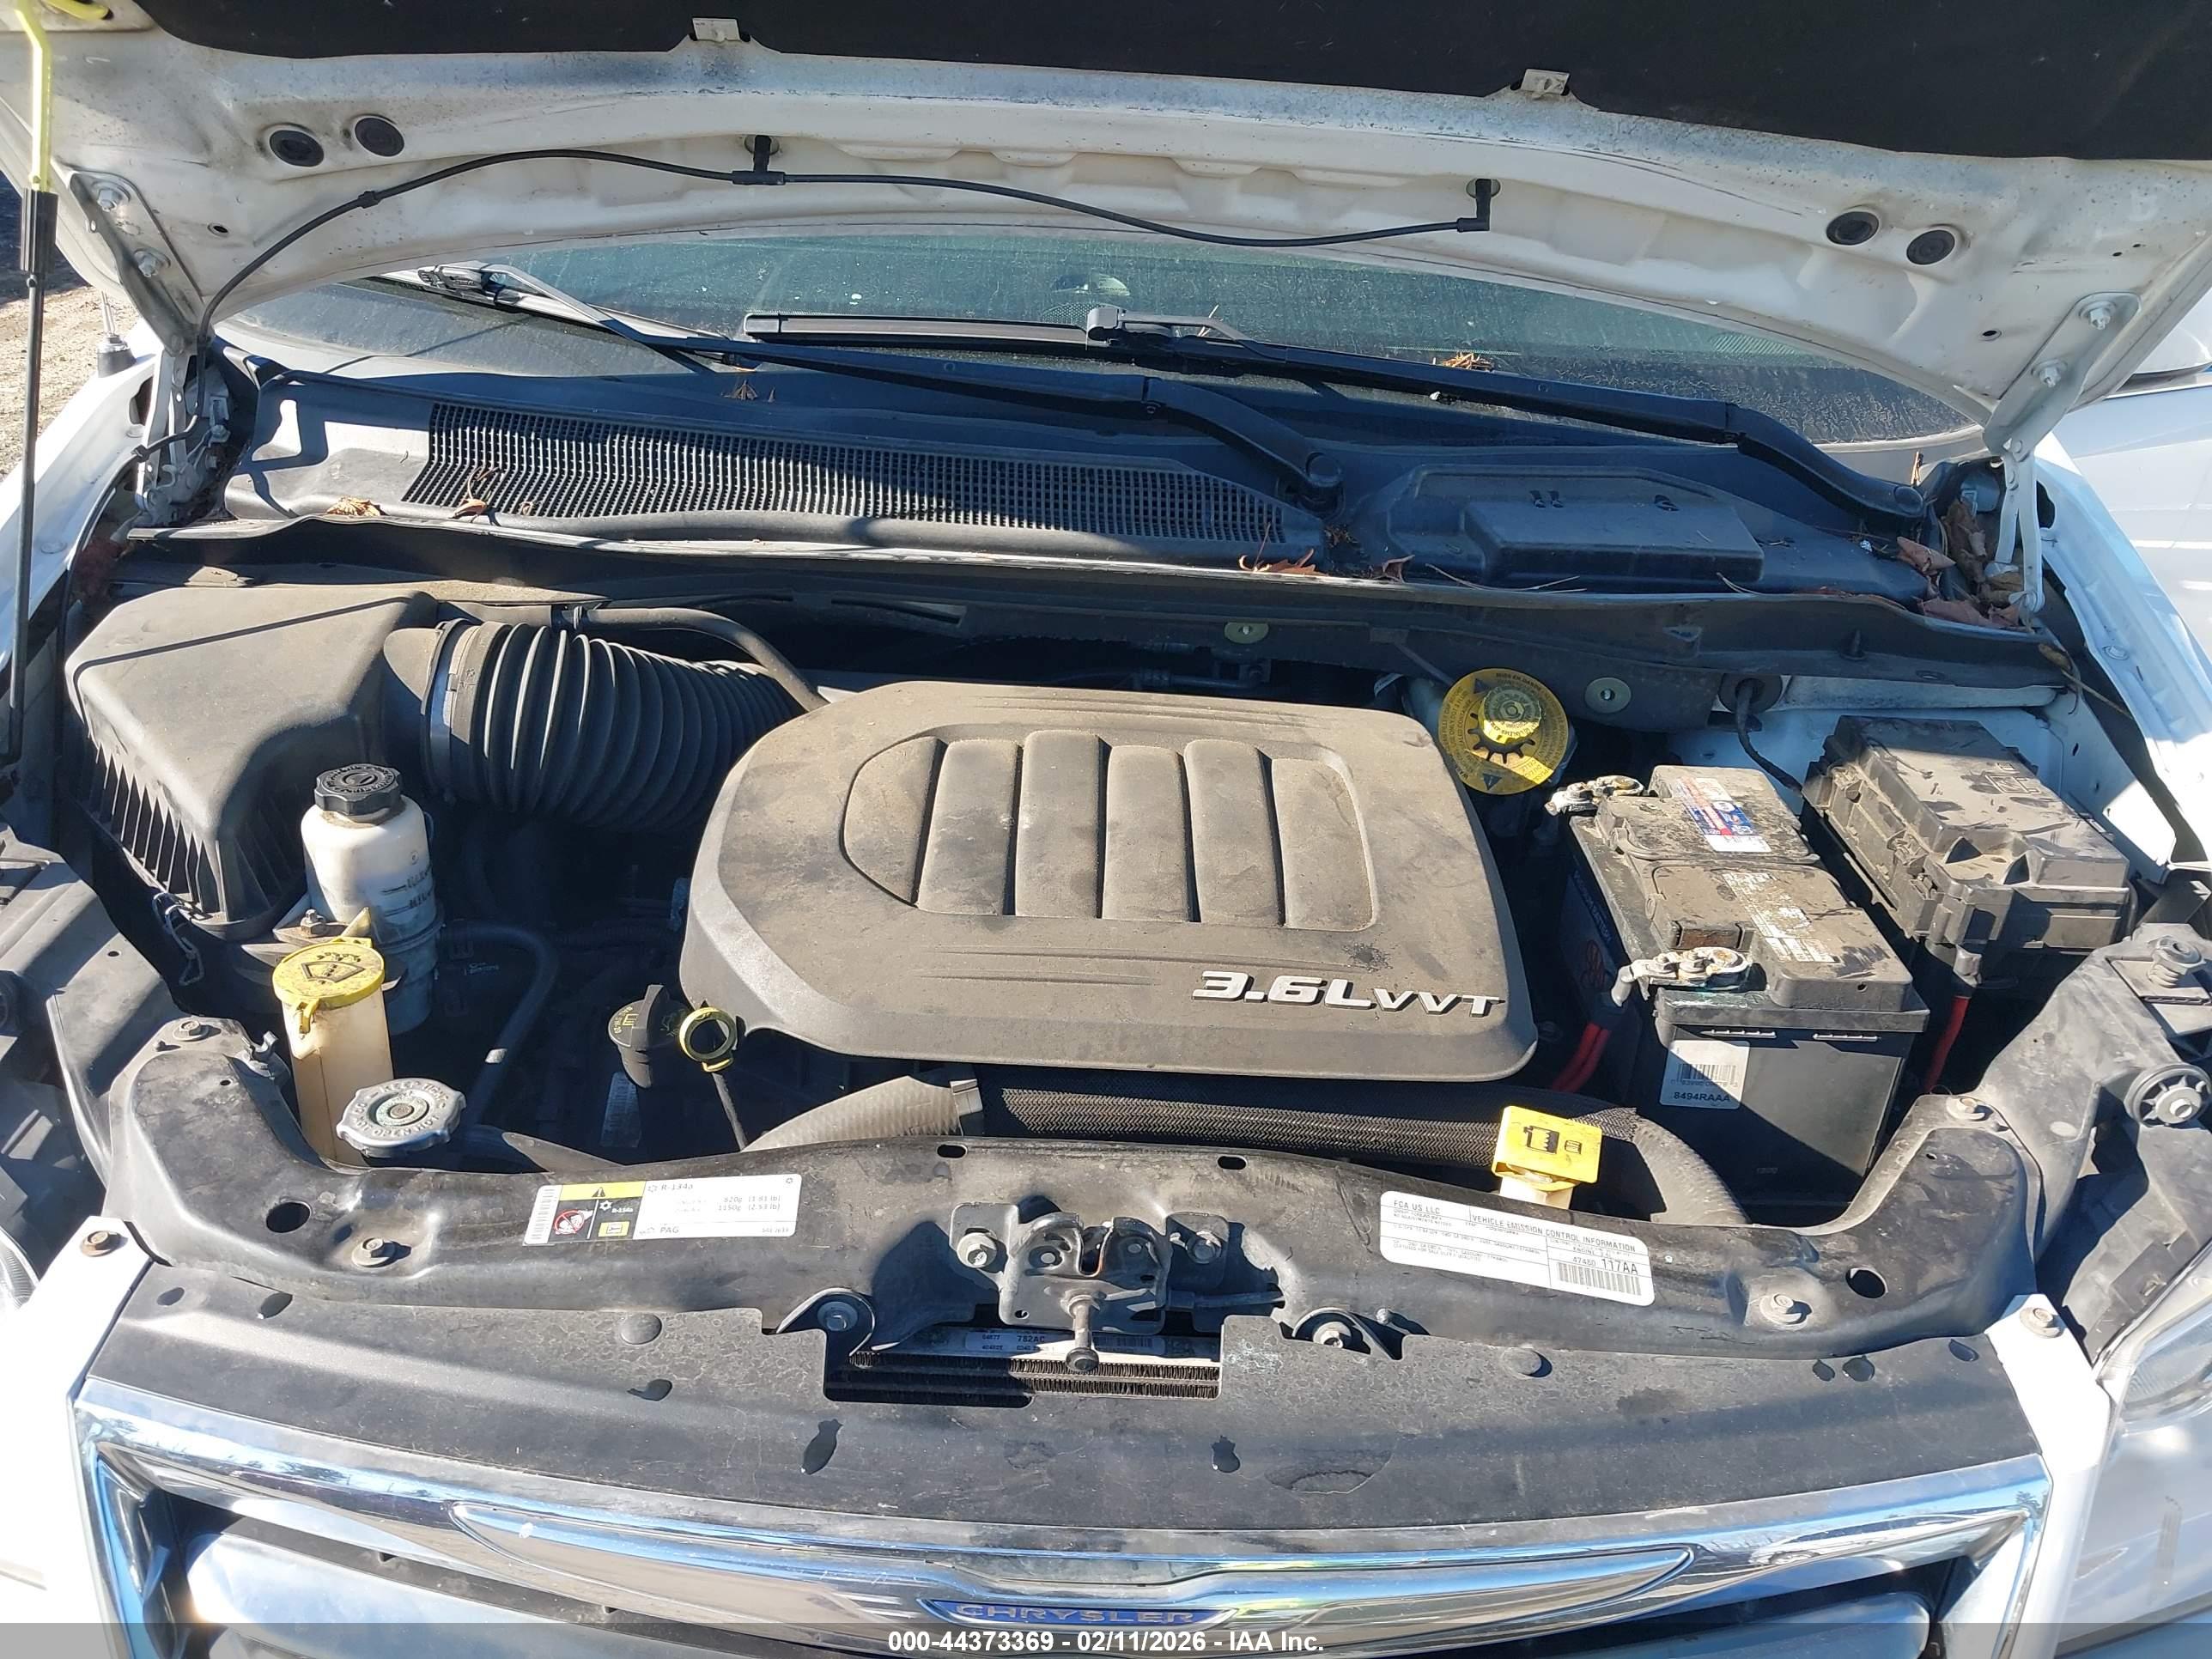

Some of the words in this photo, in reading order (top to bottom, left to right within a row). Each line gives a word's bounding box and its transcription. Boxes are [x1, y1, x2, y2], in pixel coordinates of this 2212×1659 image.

[1374, 988, 1503, 1018] VVT
[380, 1080, 420, 1093] KEEP
[1674, 1091, 1730, 1103] 8494RAAA
[374, 1128, 412, 1137] OPEN
[415, 1114, 440, 1132] HOT
[660, 1182, 694, 1192] R-134a
[1394, 1200, 1408, 1209] FCA
[1425, 1206, 1441, 1215] LLC
[1472, 1215, 1504, 1227] VEHICLE
[1507, 1221, 1543, 1235] EMISSION
[1546, 1229, 1581, 1243] CONTROL
[1583, 1237, 1636, 1253] INFORMATION
[1601, 1259, 1639, 1276] 117AA
[956, 1604, 1194, 1624] CHRYSLER
